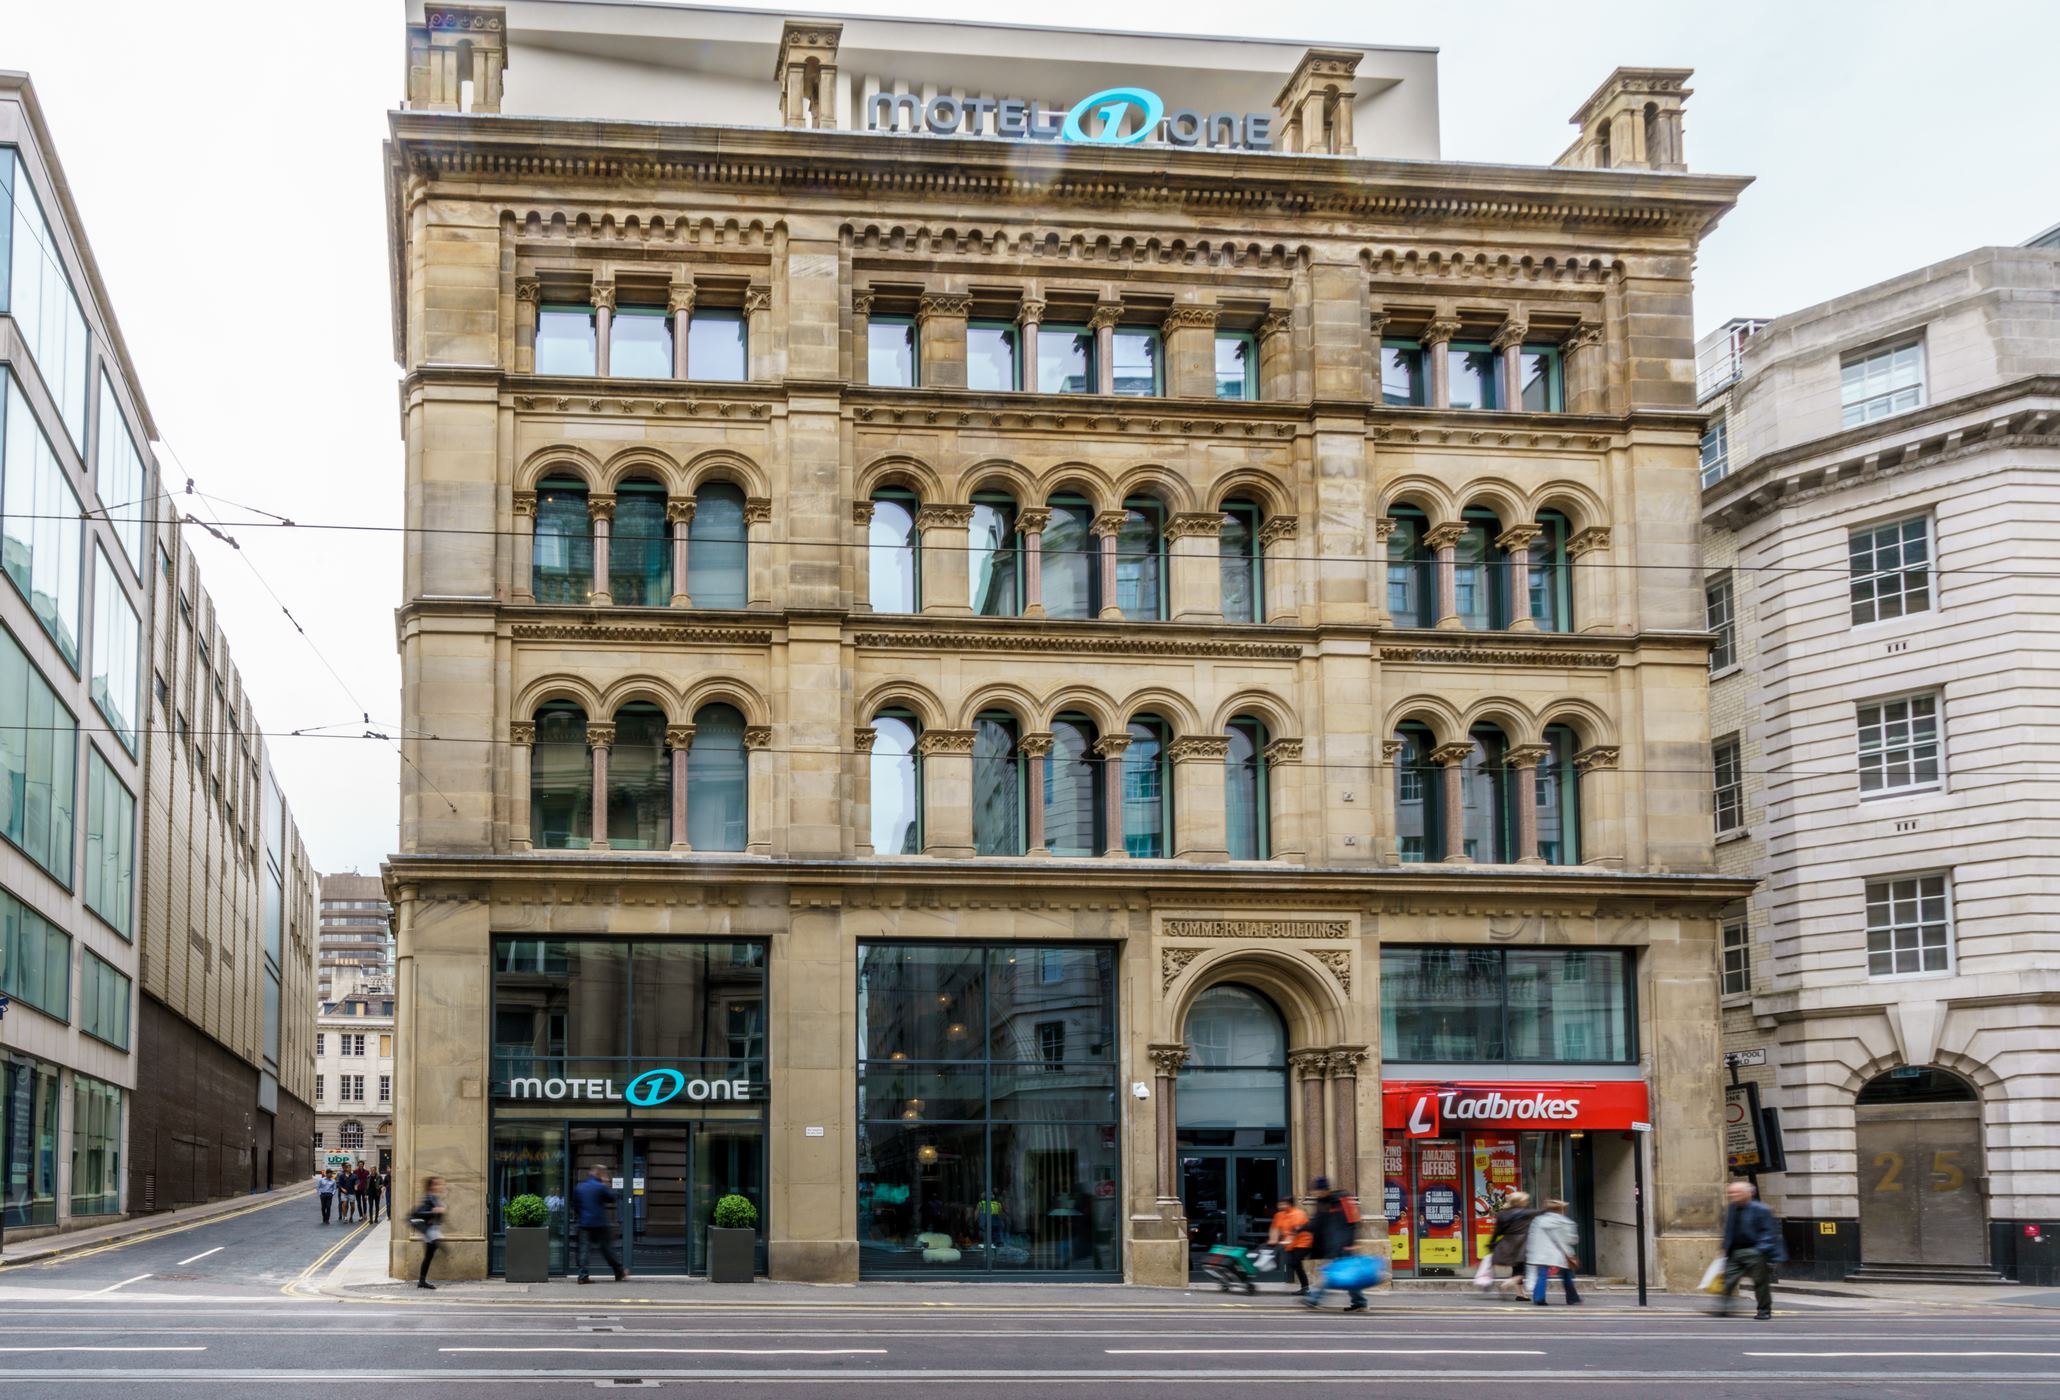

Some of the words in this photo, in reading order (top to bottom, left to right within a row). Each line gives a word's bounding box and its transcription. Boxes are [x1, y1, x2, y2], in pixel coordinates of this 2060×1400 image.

[868, 92, 1058, 138] MOTEL
[1168, 108, 1274, 150] ONE
[1167, 920, 1269, 938] COMMERCIAL
[1272, 921, 1346, 938] BUILDINGS
[510, 1077, 623, 1099] MOTEL
[687, 1079, 750, 1100] ONE
[1442, 1092, 1580, 1119] Ladbrokes
[1408, 1096, 1432, 1135] L
[1384, 1146, 1402, 1157] ZING
[1422, 1150, 1456, 1161] AMAZING
[1384, 1157, 1402, 1172] ERS
[1422, 1161, 1456, 1176] OFFERS
[1425, 1191, 1431, 1203] 5
